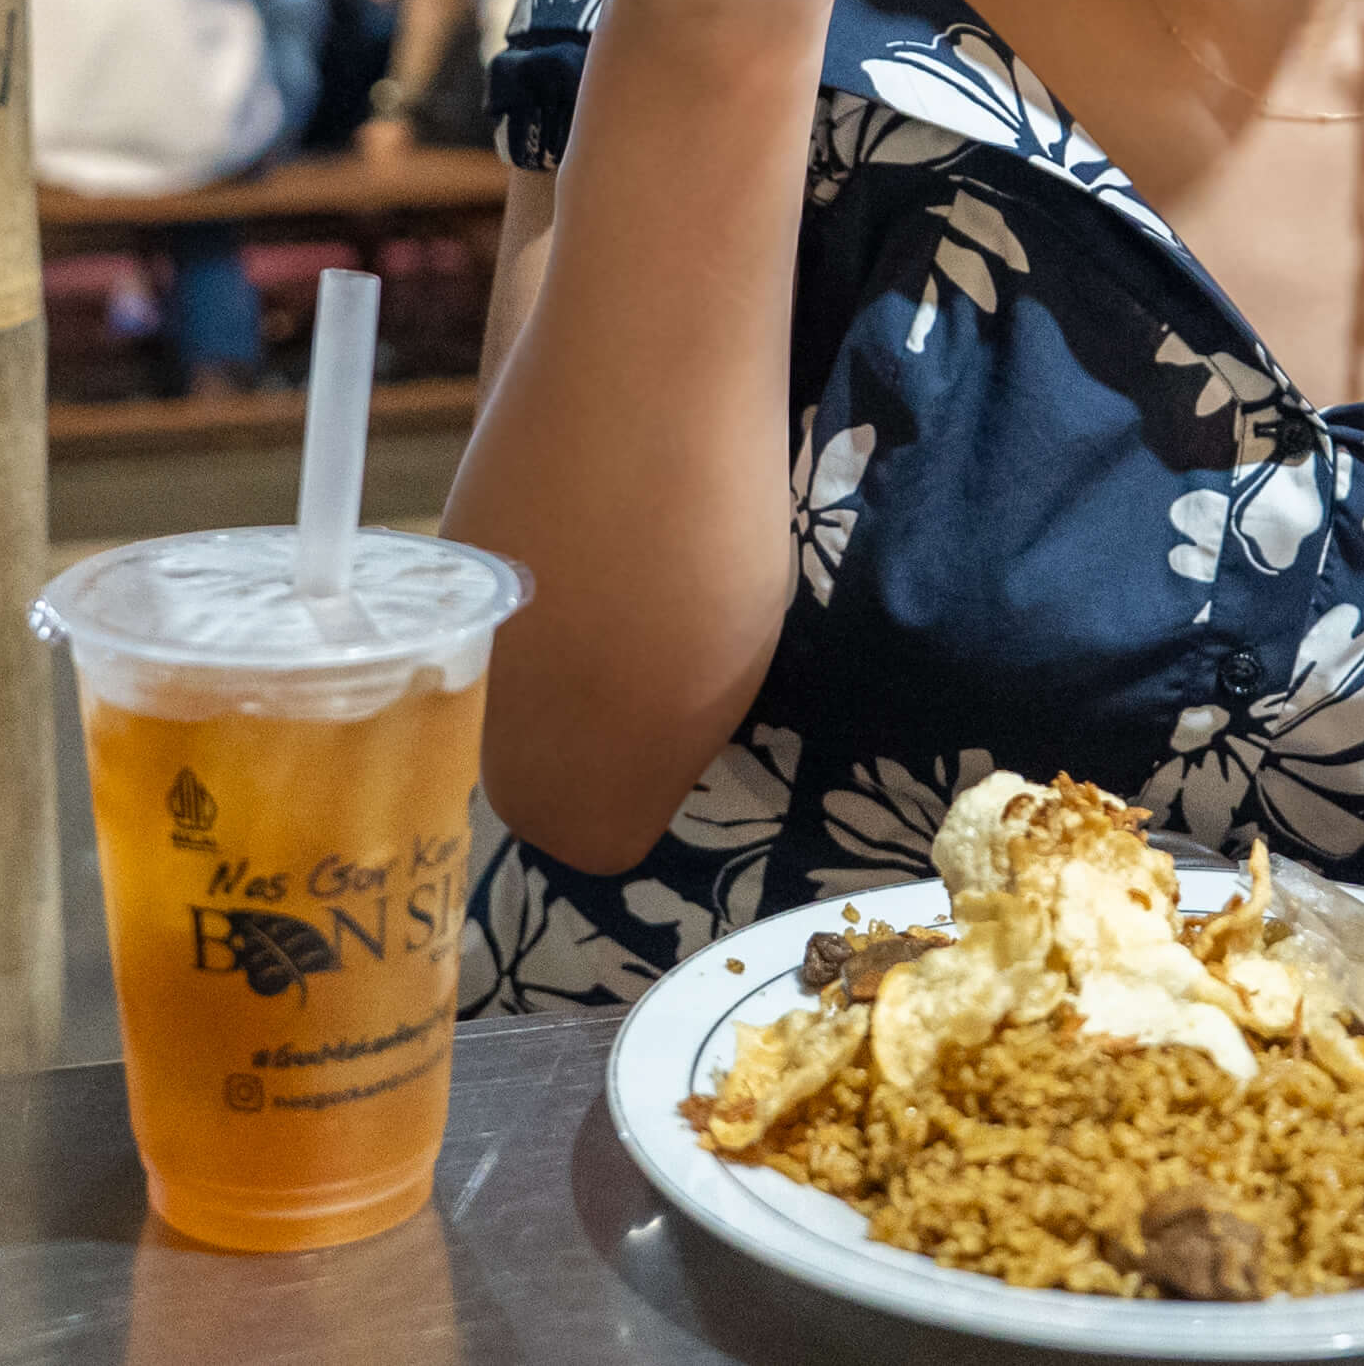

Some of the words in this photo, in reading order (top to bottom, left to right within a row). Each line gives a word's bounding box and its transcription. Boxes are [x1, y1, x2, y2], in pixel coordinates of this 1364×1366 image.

[208, 857, 288, 902] Nas
[307, 852, 398, 900] Gor
[190, 894, 387, 976] BN
